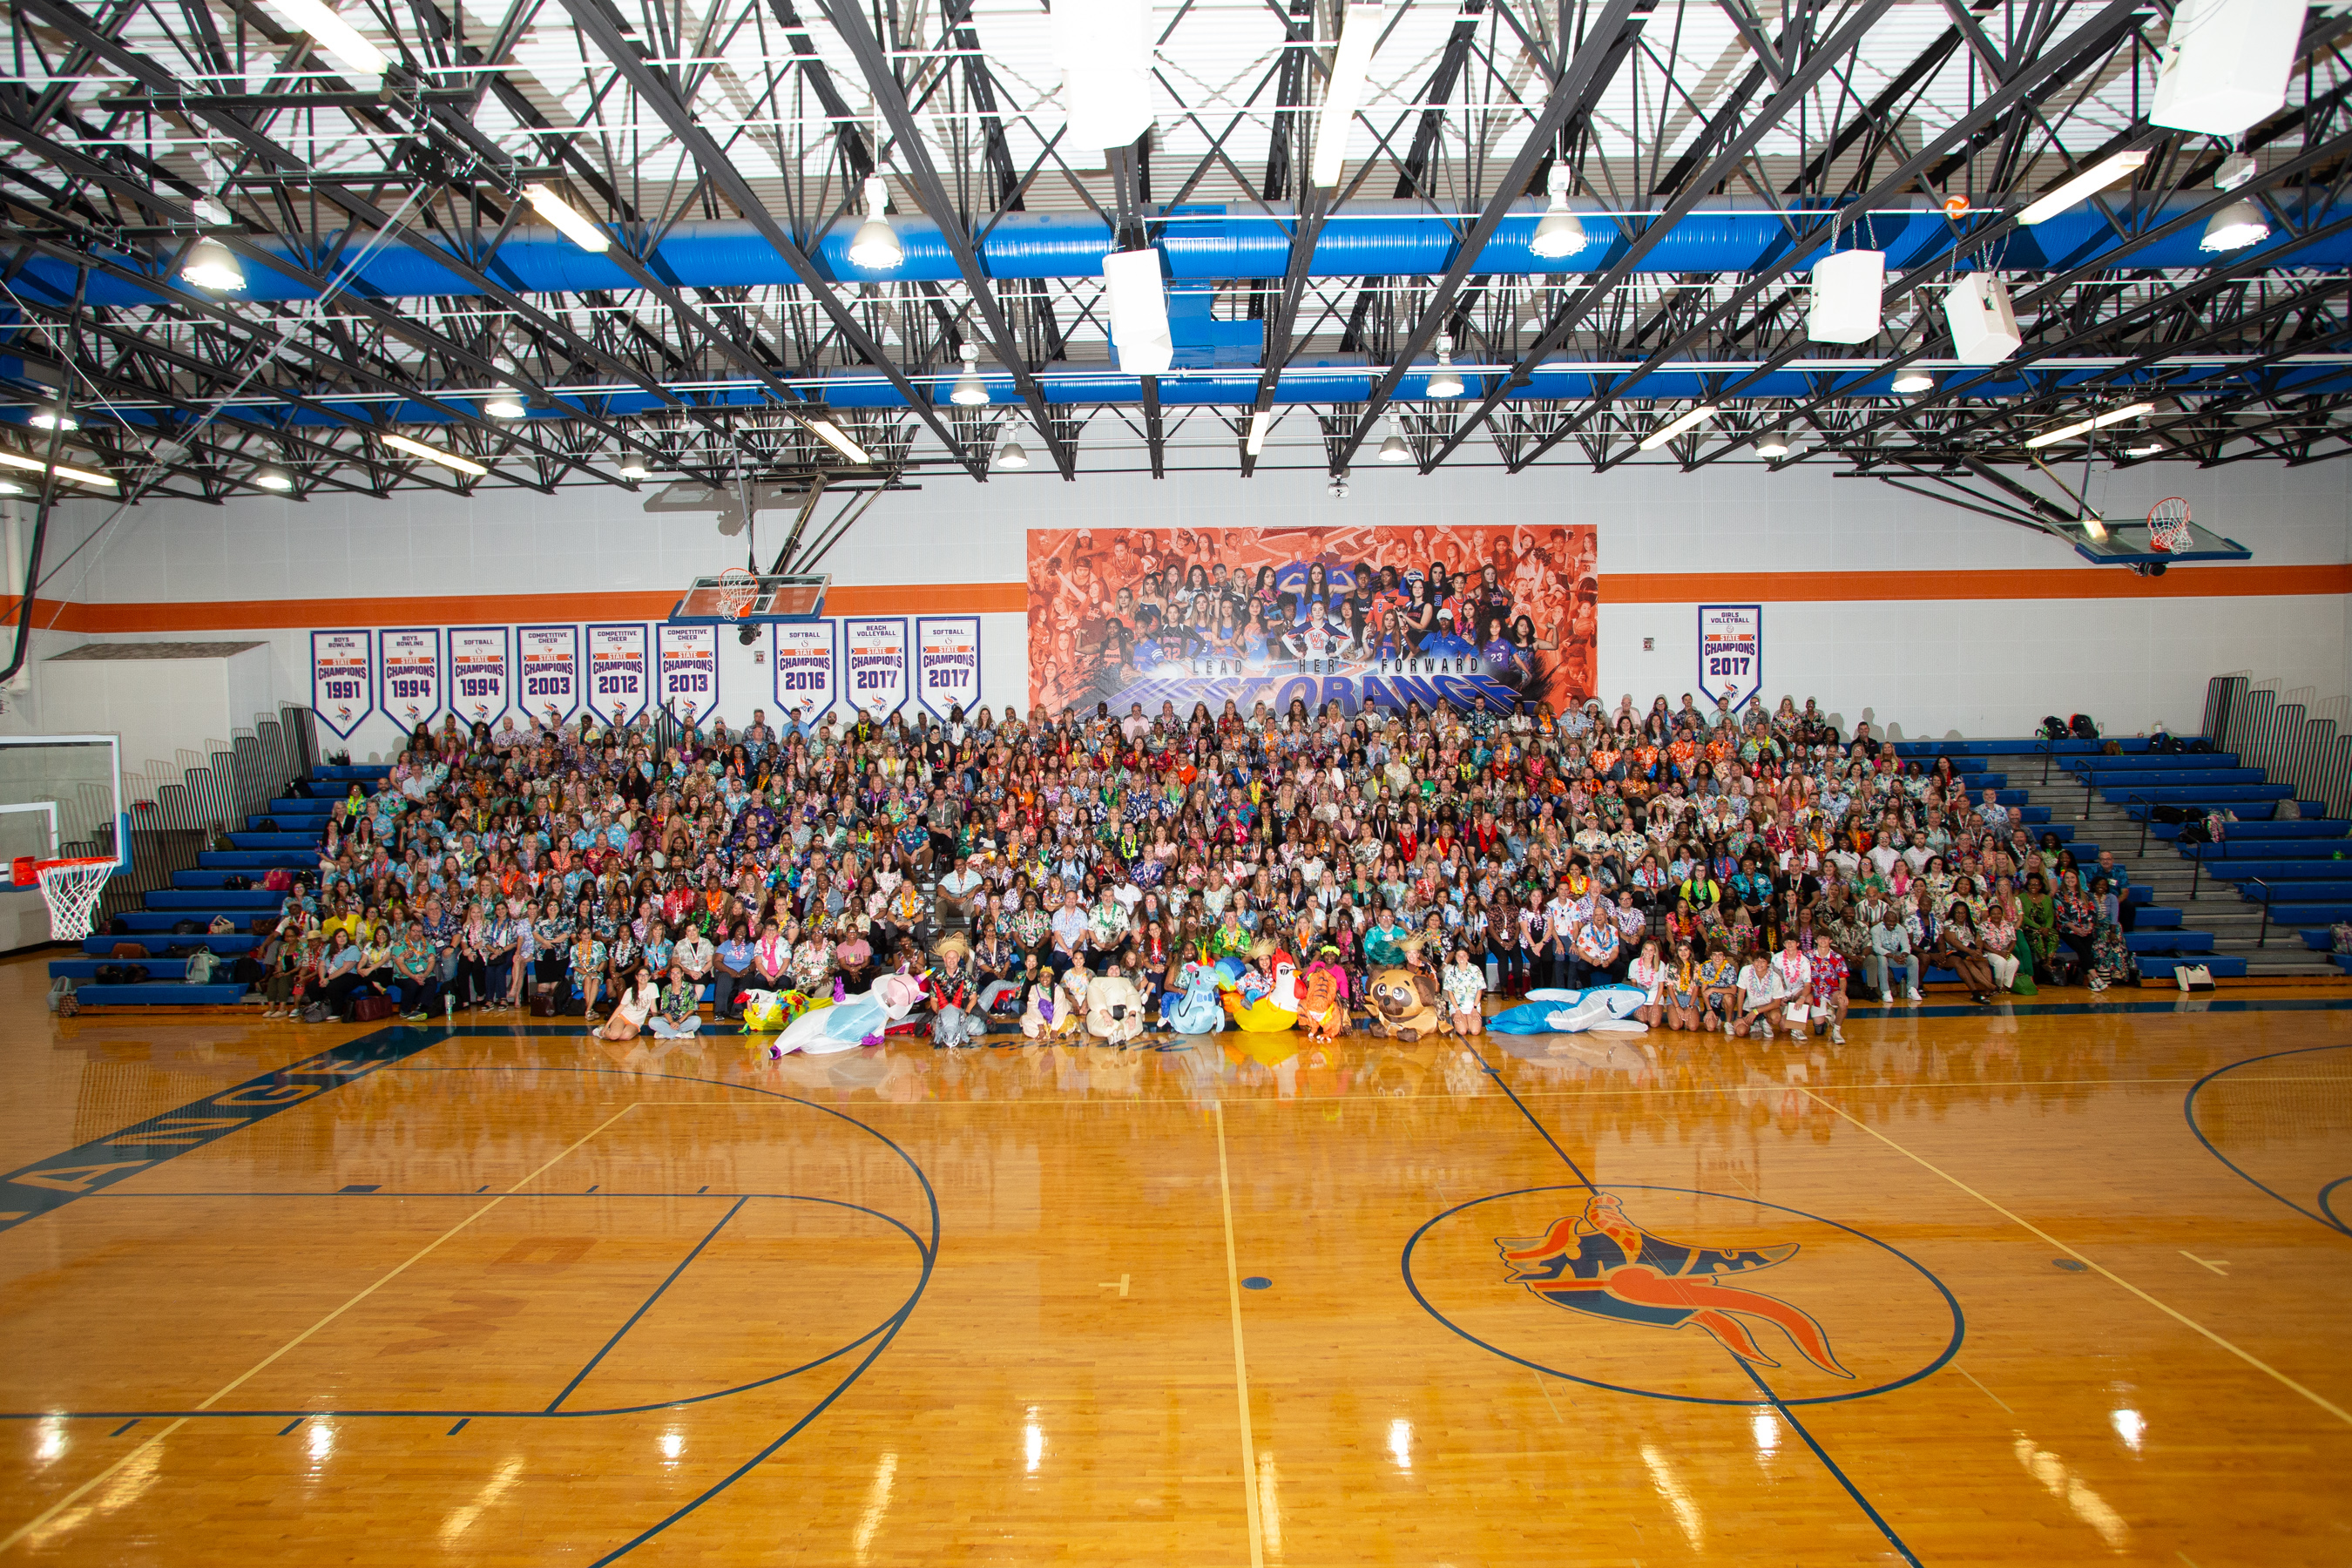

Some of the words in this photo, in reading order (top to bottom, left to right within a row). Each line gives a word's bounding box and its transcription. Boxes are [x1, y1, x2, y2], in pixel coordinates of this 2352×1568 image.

[1164, 646, 1180, 660] 32
[1490, 652, 1502, 662] 23
[1705, 643, 1754, 656] CHAMPIONS
[524, 662, 573, 676] CHAMPIONS
[593, 660, 643, 674] CHAMPIONS
[663, 659, 713, 673] CHAMPIONS
[780, 657, 830, 671] CHAMPIONS
[852, 655, 902, 669] CHAMPIONS
[923, 654, 974, 667] CHAMPIONS
[1193, 659, 1242, 674] LEAD
[1298, 659, 1336, 674] HER
[1382, 657, 1478, 673] FORWARD
[1710, 657, 1749, 675] 2017
[319, 666, 366, 679] CHAMPIONS
[387, 666, 435, 678] CHAMPIONS
[455, 664, 504, 677] CHAMPIONS
[929, 669, 970, 687] 2017
[392, 679, 430, 697] 1994
[460, 678, 500, 696] 1994
[528, 677, 570, 695] 2003
[599, 676, 638, 693] 2012
[669, 674, 707, 692] 2013
[786, 672, 825, 690] 2016
[857, 671, 897, 688] 2017
[326, 681, 361, 699] 1991
[1274, 674, 1554, 722] ORANGE
[0, 1059, 389, 1220] ANGE
